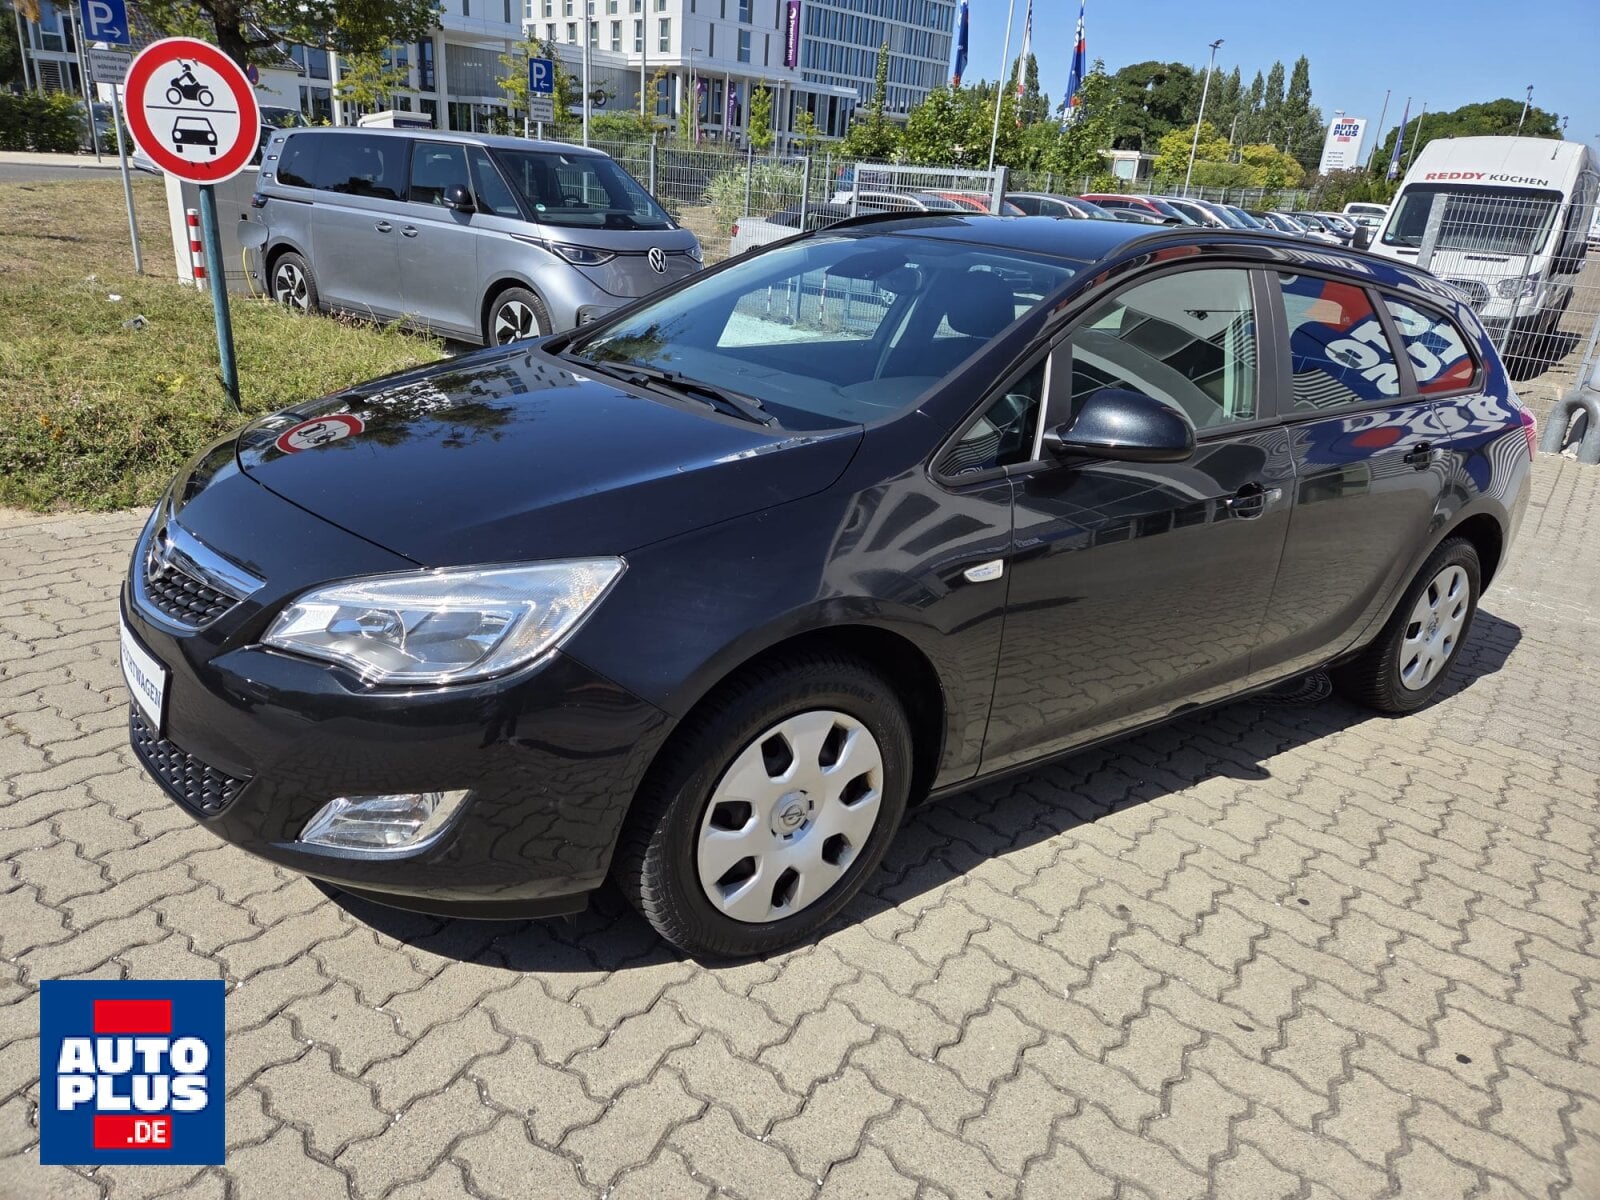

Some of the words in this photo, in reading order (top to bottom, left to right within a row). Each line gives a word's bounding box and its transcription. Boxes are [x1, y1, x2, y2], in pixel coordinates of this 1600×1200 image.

[88, 1, 113, 36] P
[533, 62, 546, 88] P
[1335, 123, 1360, 131] AUTO
[1425, 172, 1486, 181] REDDY
[1489, 173, 1549, 187] KÜCHEN
